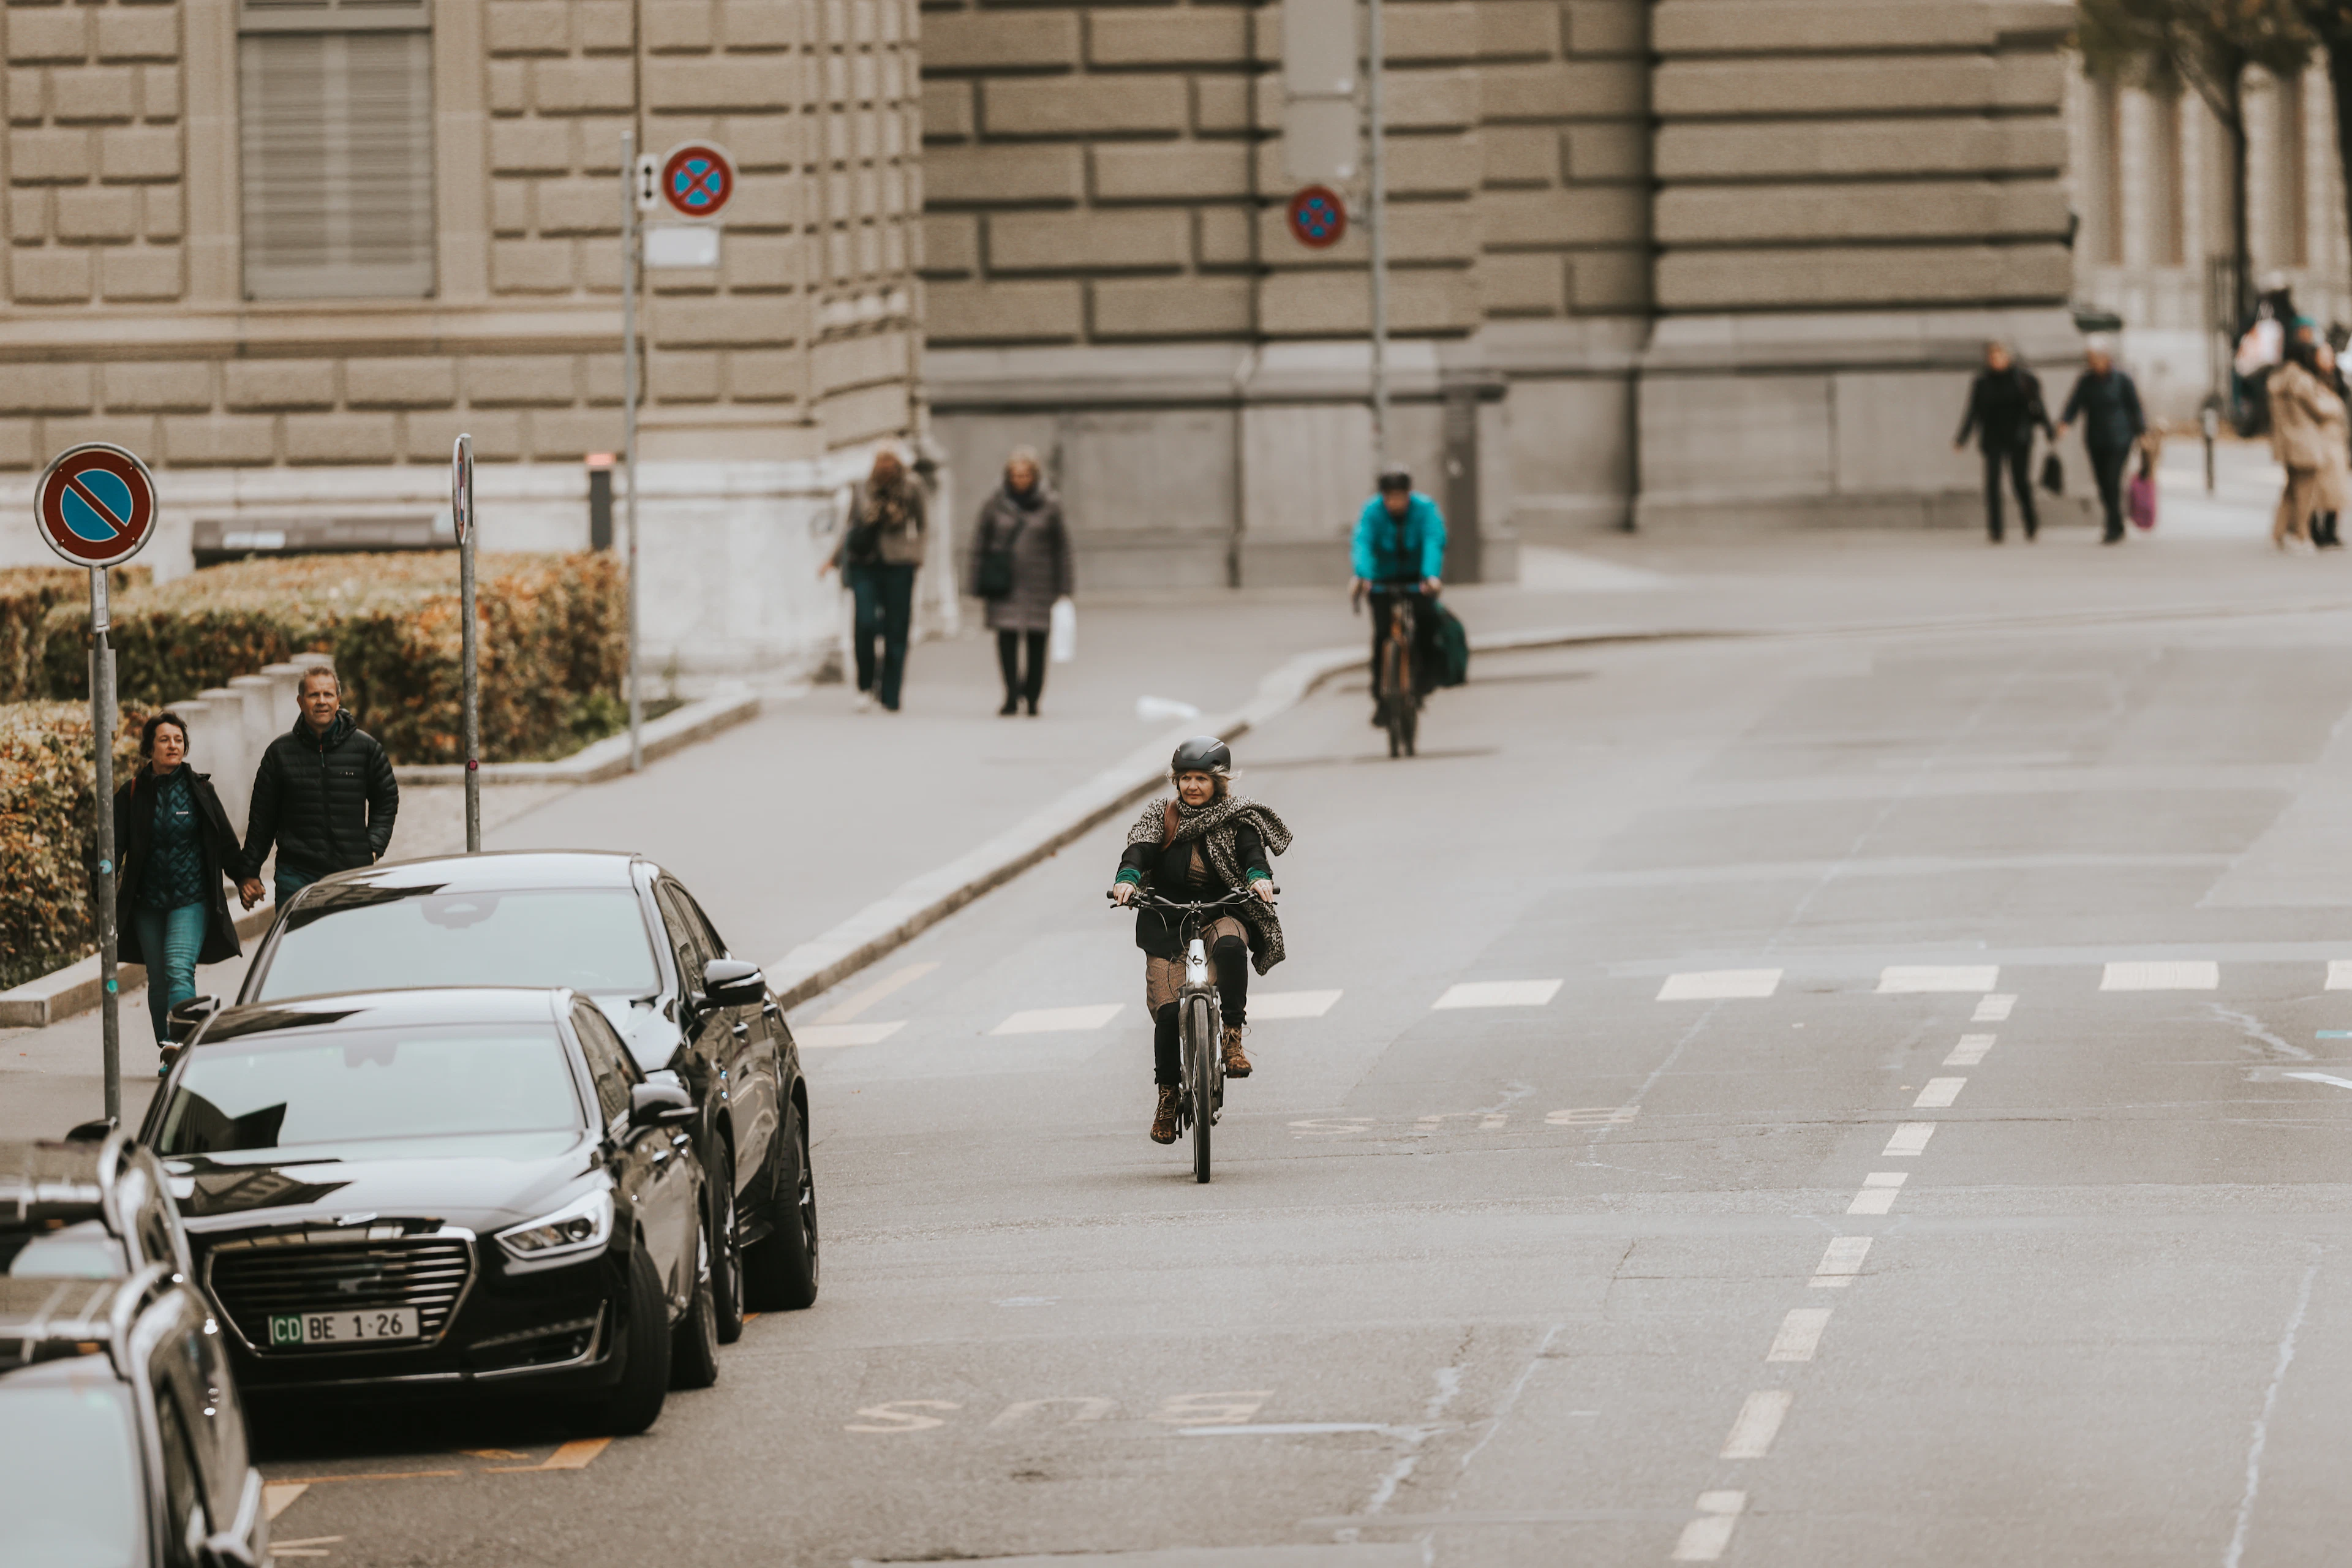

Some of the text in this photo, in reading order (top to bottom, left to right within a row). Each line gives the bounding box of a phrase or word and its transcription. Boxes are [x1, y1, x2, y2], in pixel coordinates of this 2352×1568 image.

[275, 1317, 301, 1341] CD
[309, 1316, 336, 1340] BE
[843, 1389, 1275, 1433] BUS
